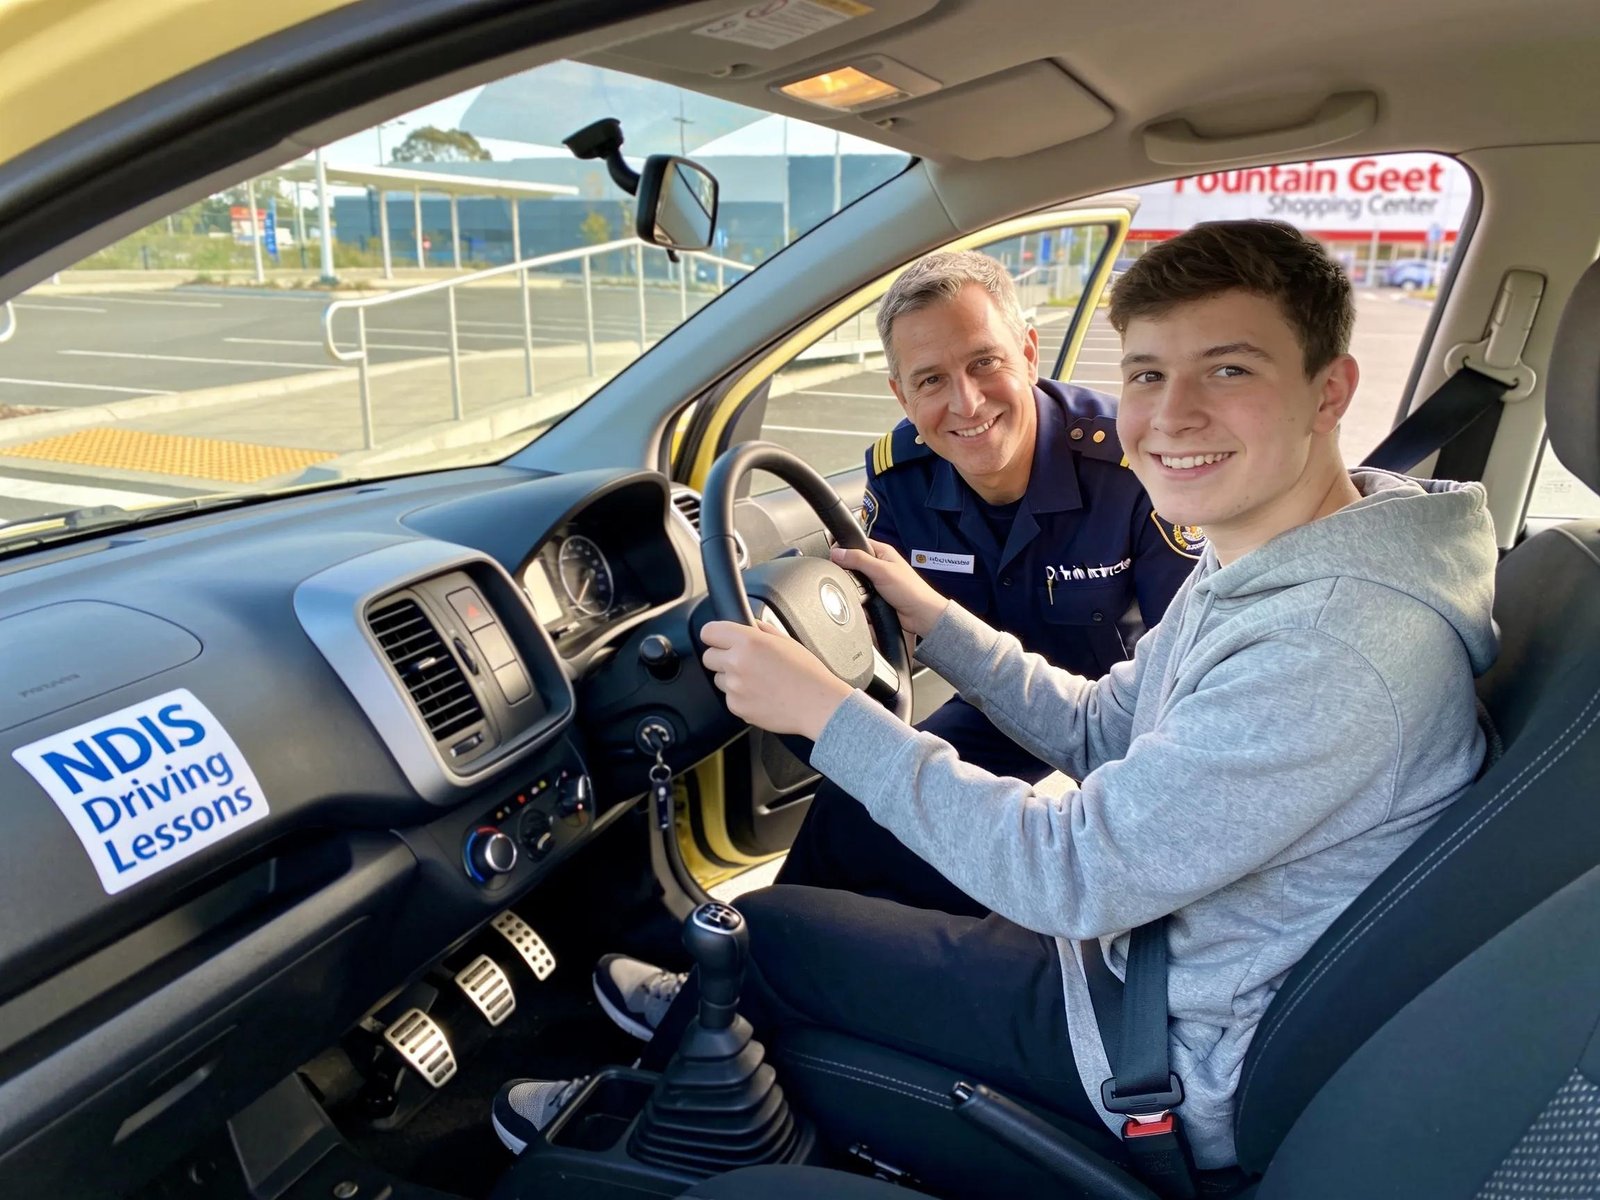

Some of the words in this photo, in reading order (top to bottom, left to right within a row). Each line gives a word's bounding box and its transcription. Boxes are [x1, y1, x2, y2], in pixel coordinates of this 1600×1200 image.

[1267, 195, 1362, 219] Shopping
[1368, 194, 1438, 214] Center
[1349, 160, 1444, 193] Geet
[40, 704, 206, 795] NDIS
[81, 752, 234, 834] Driving
[104, 786, 253, 873] Lessons
